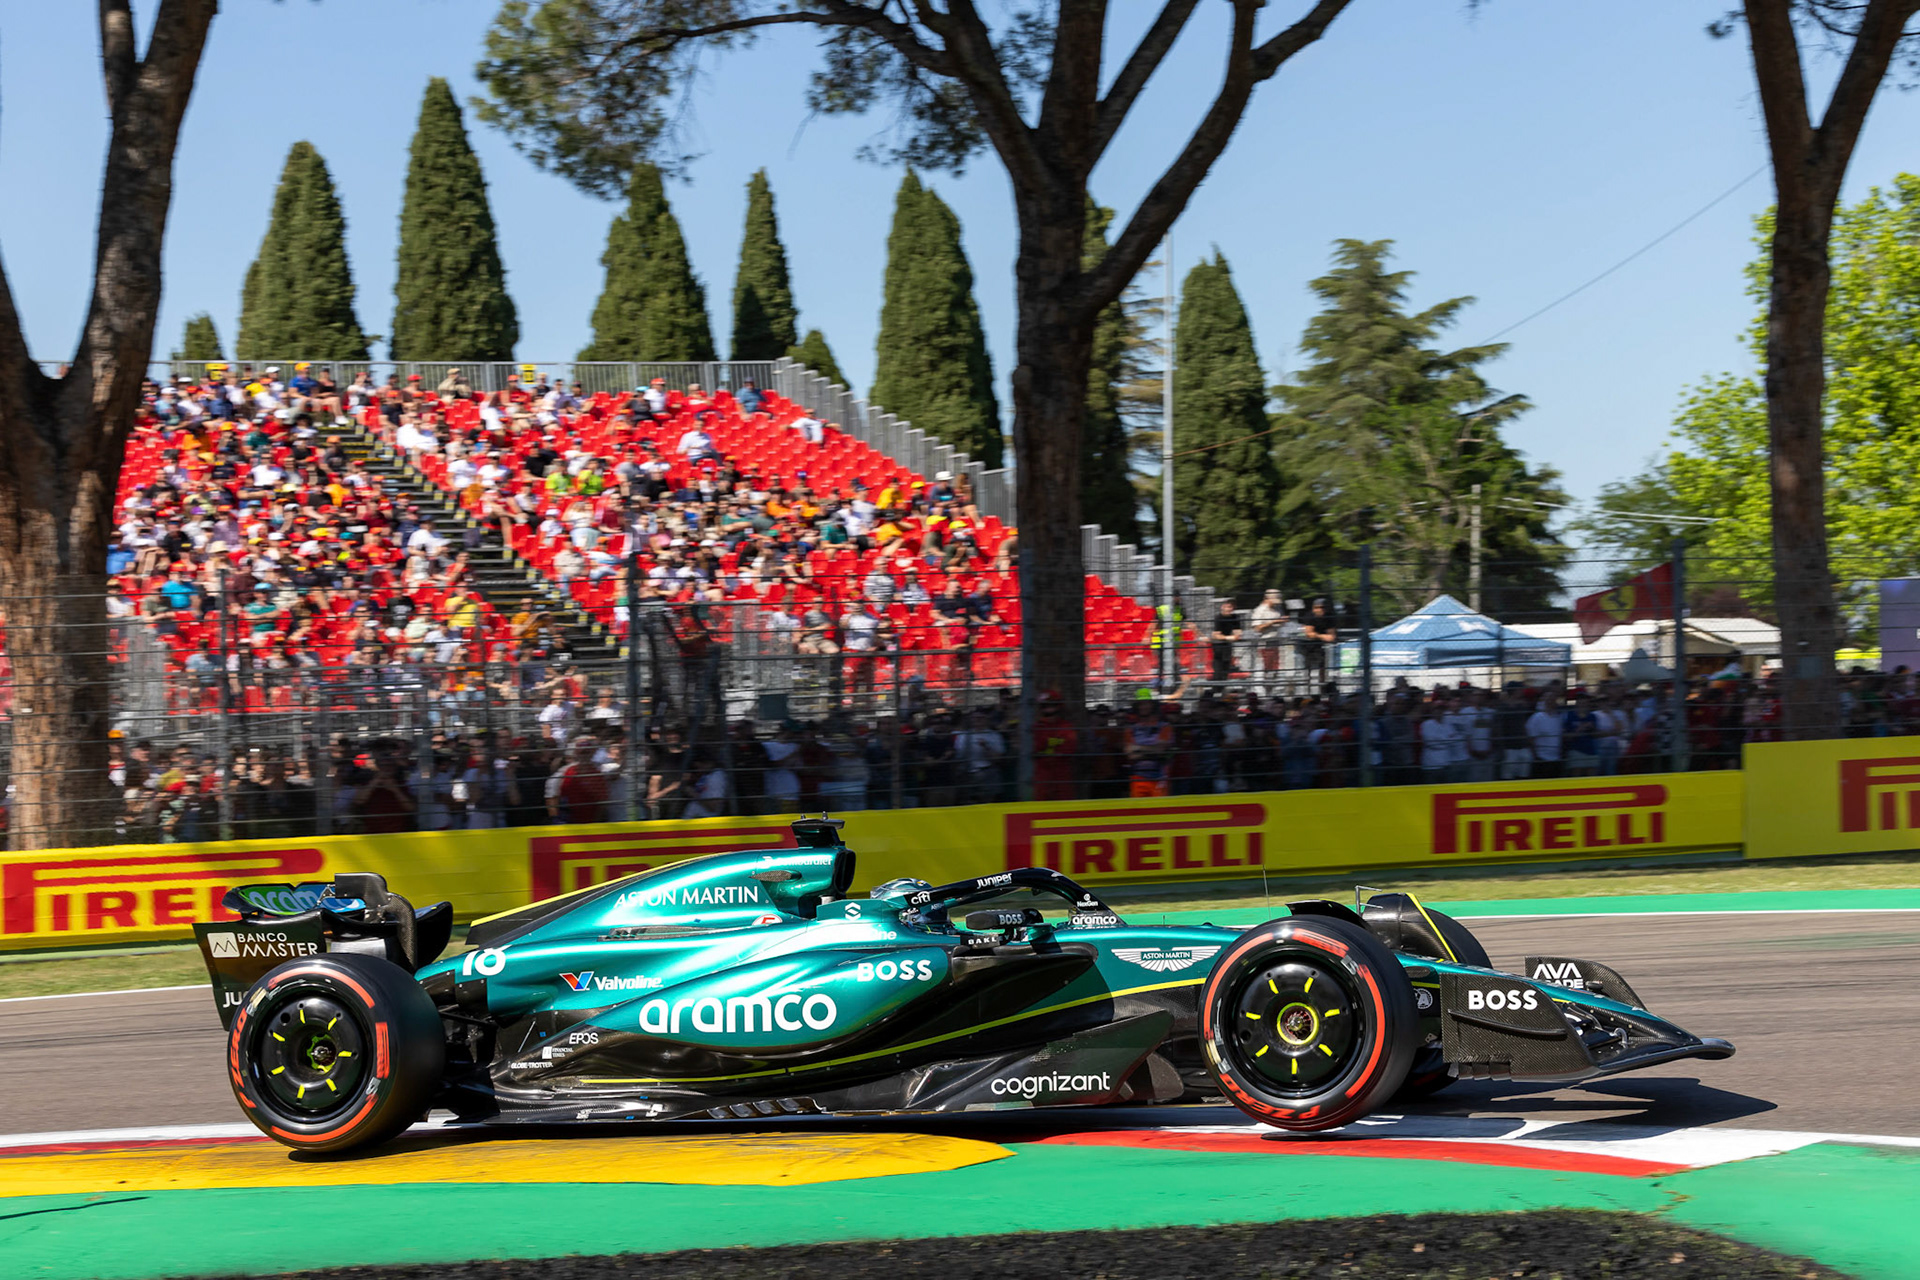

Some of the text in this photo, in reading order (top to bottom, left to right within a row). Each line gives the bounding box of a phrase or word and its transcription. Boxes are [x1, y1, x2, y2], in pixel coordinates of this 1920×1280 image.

[1432, 784, 1669, 854] PIRELLI
[1004, 803, 1266, 874] PIRELLI
[2, 848, 325, 934] PIREL
[613, 886, 759, 908] ASTON MARTIN
[999, 914, 1023, 925] BOSS
[1072, 915, 1117, 925] aramco
[238, 932, 287, 943] BANCO
[242, 942, 319, 957] MASTER
[1165, 951, 1191, 959] MARTIN
[857, 959, 933, 982] BOSS
[1532, 962, 1582, 979] AVA
[1468, 989, 1538, 1010] BOSS
[639, 993, 837, 1034] aramco
[569, 1032, 599, 1044] EPOS
[990, 1070, 1111, 1099] cognizant
